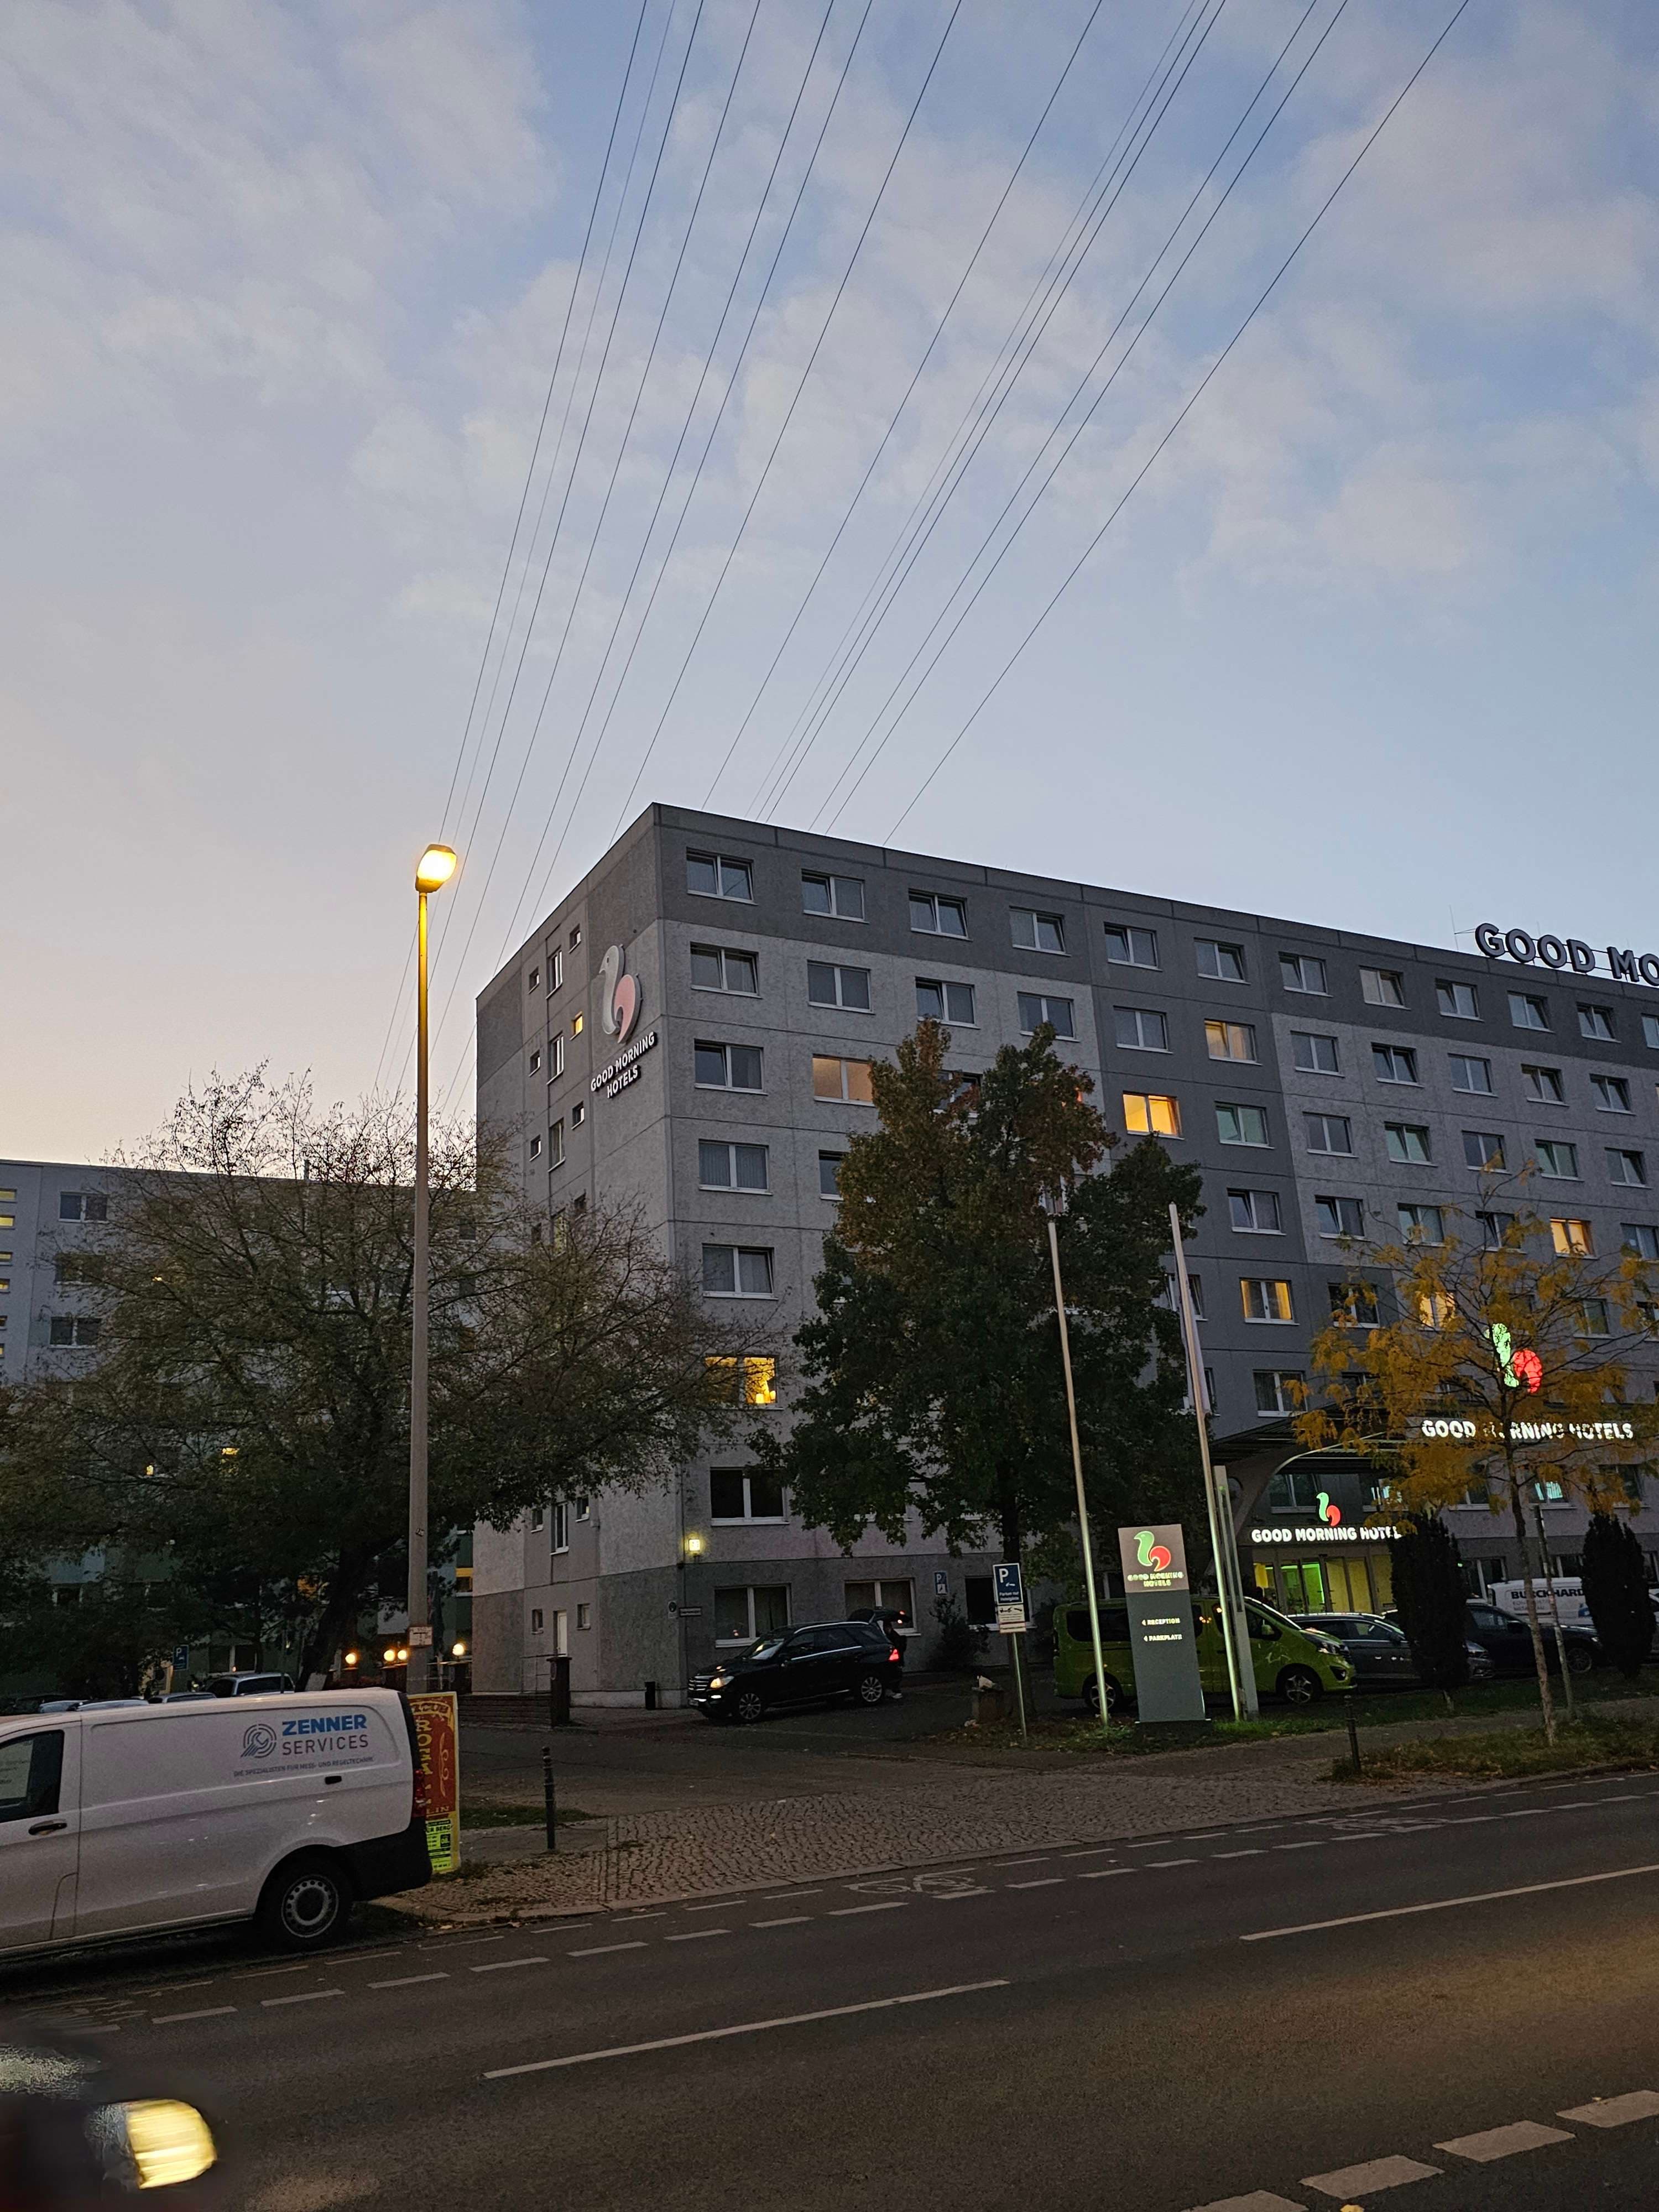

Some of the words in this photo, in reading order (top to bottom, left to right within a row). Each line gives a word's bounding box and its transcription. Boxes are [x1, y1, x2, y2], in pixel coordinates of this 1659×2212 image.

[1475, 922, 1596, 973] GOOD
[591, 1065, 614, 1092] GOOD
[615, 1031, 655, 1073] MORNING
[607, 1064, 639, 1098] HOTELS
[1421, 1420, 1477, 1438] GOOD
[1251, 1528, 1292, 1543] GOOD
[1295, 1527, 1358, 1542] MORNING
[1359, 1526, 1403, 1540] HOTEL
[999, 1568, 1009, 1583] P
[1511, 1588, 1585, 1599] BUCKHARD
[282, 1714, 367, 1736] ZENNER
[282, 1734, 369, 1756] SERVICES
